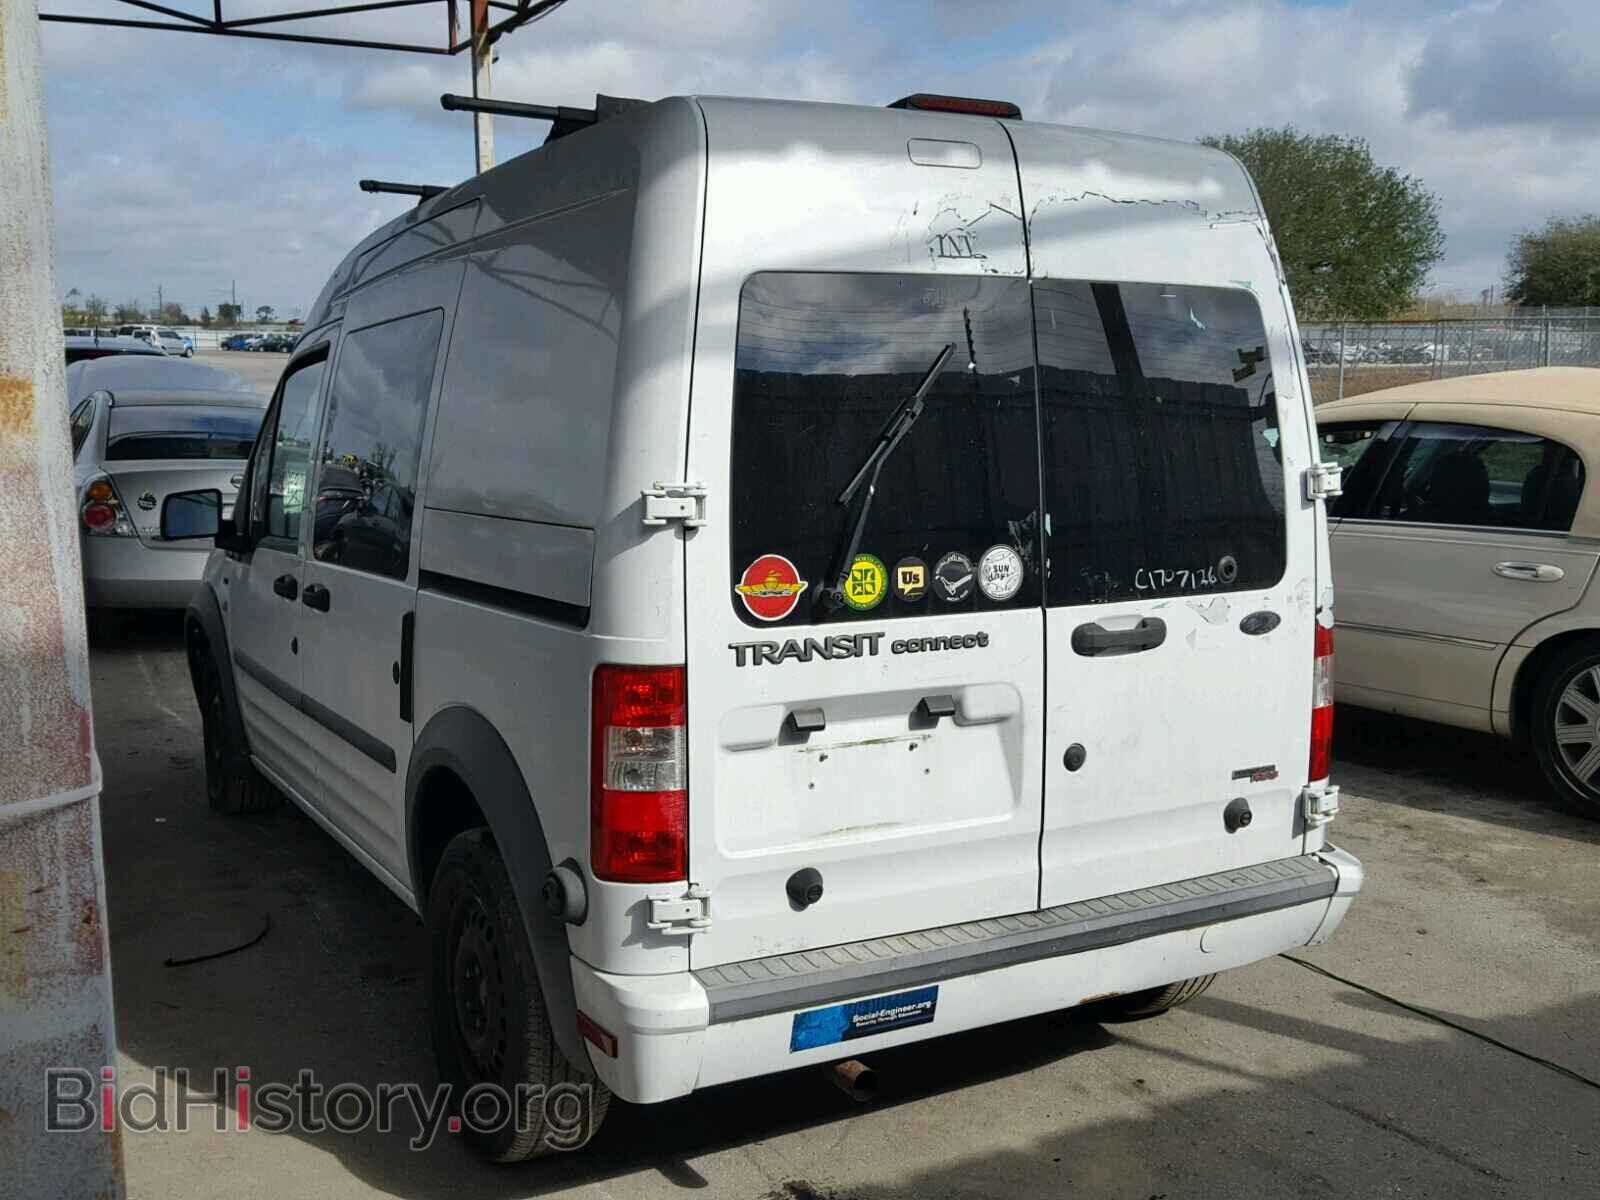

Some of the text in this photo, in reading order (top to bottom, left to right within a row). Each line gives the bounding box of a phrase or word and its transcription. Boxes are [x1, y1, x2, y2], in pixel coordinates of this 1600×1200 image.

[993, 564, 1010, 573] SUN
[901, 571, 920, 585] Us
[728, 631, 989, 667] TRANSIT connect
